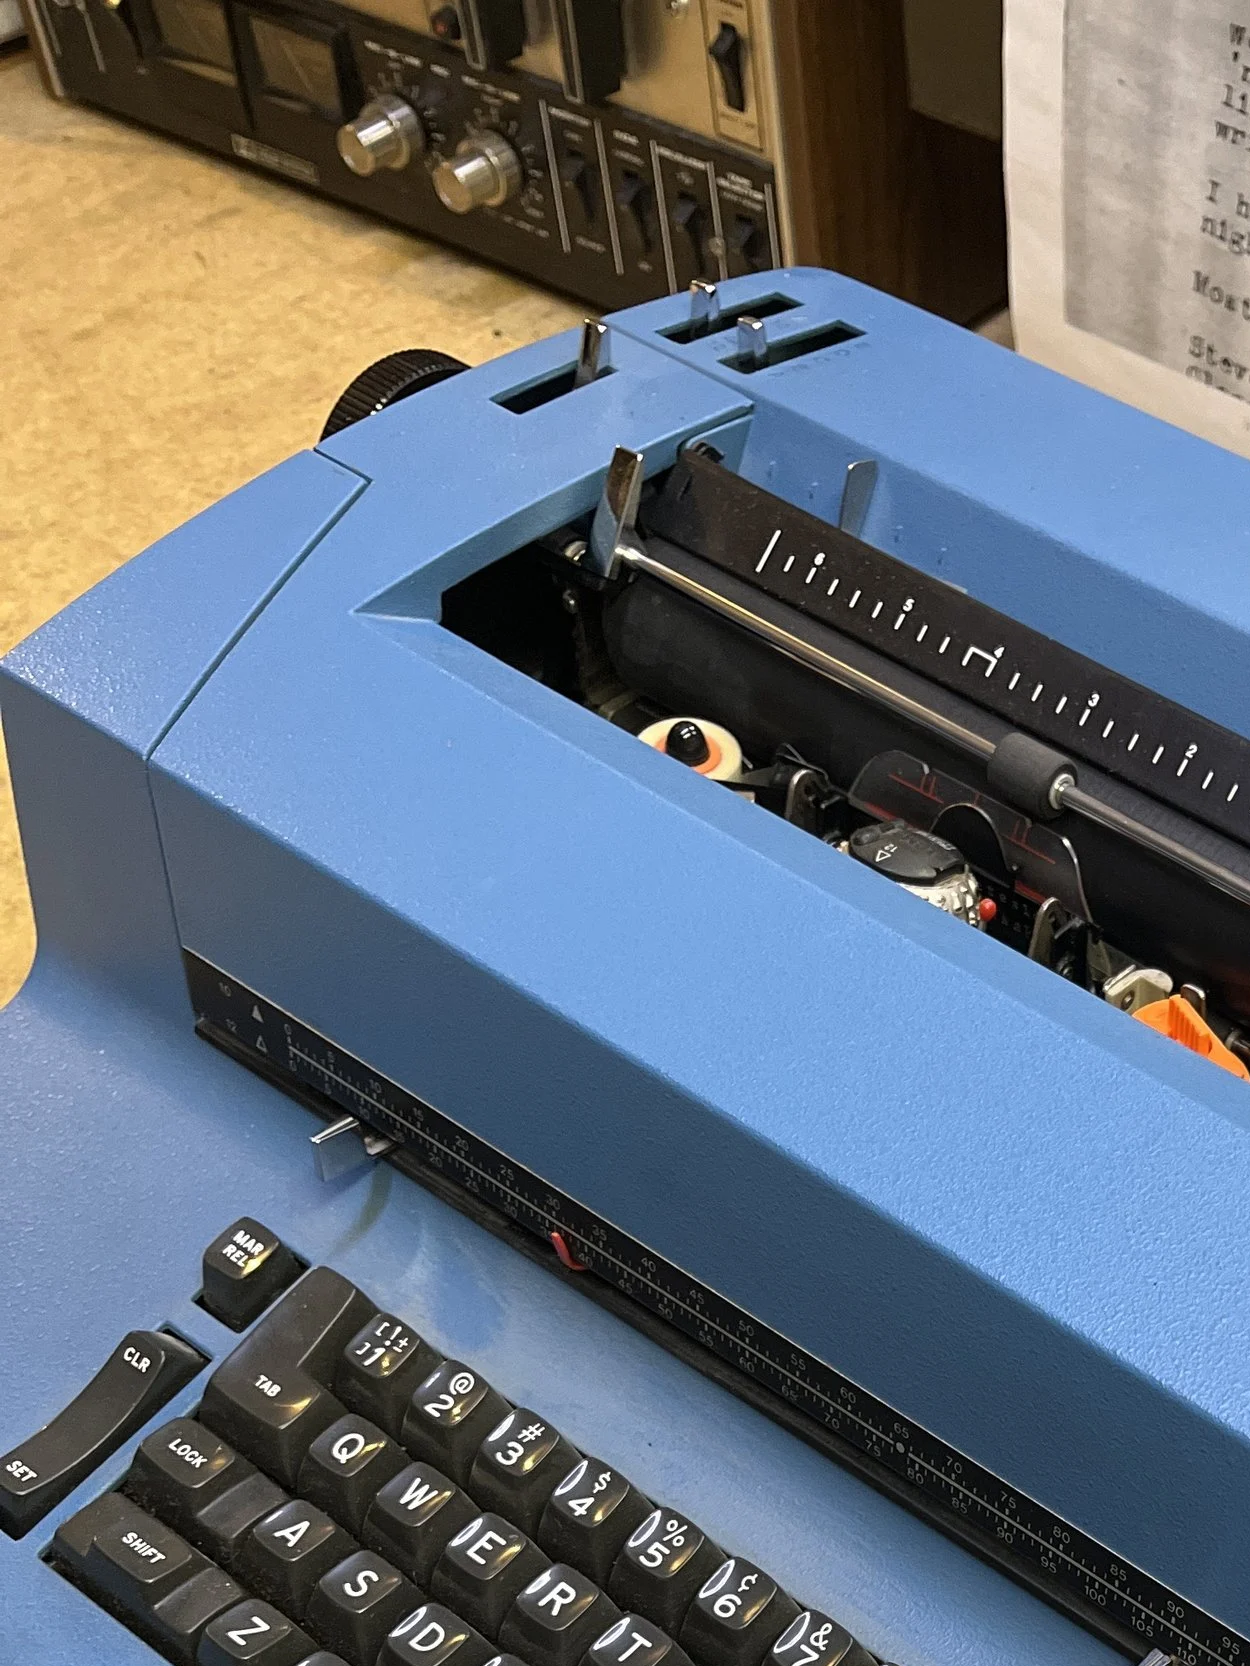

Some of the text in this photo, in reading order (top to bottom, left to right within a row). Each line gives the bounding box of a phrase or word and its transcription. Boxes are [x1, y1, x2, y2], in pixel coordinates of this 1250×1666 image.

[1206, 179, 1221, 203] I
[814, 552, 826, 566] 6
[902, 598, 915, 612] 5
[1087, 693, 1100, 707] 3
[1185, 743, 1199, 759] 2
[222, 1243, 249, 1268] REL
[232, 1229, 265, 1256] MAR
[123, 1346, 151, 1373] CLR
[254, 1374, 283, 1398] TAB
[423, 1394, 455, 1418] 2
[168, 1438, 208, 1469] LOCK
[332, 1432, 366, 1465] Q
[495, 1443, 526, 1467] 3
[5, 1460, 38, 1484] SET
[398, 1476, 439, 1512] W
[738, 1319, 754, 1337] 50
[840, 1386, 857, 1404] 60
[893, 1421, 910, 1440] 65
[945, 1455, 963, 1474] 70
[1000, 1490, 1017, 1509] 75
[1052, 1525, 1070, 1544] 80
[1109, 1563, 1128, 1582] 85
[1166, 1600, 1185, 1619] 90
[1221, 1636, 1240, 1655] 95
[567, 1496, 596, 1517] 4
[121, 1531, 166, 1564] SHIFT
[273, 1520, 311, 1548] A
[466, 1529, 508, 1566] E
[639, 1540, 671, 1568] 5
[343, 1569, 380, 1598] S
[538, 1581, 577, 1617] R
[712, 1593, 743, 1618] 6
[1083, 1585, 1107, 1606] 100
[1130, 1615, 1154, 1638] 105
[226, 1615, 271, 1646] Z
[408, 1621, 446, 1652] D
[617, 1631, 652, 1663] T
